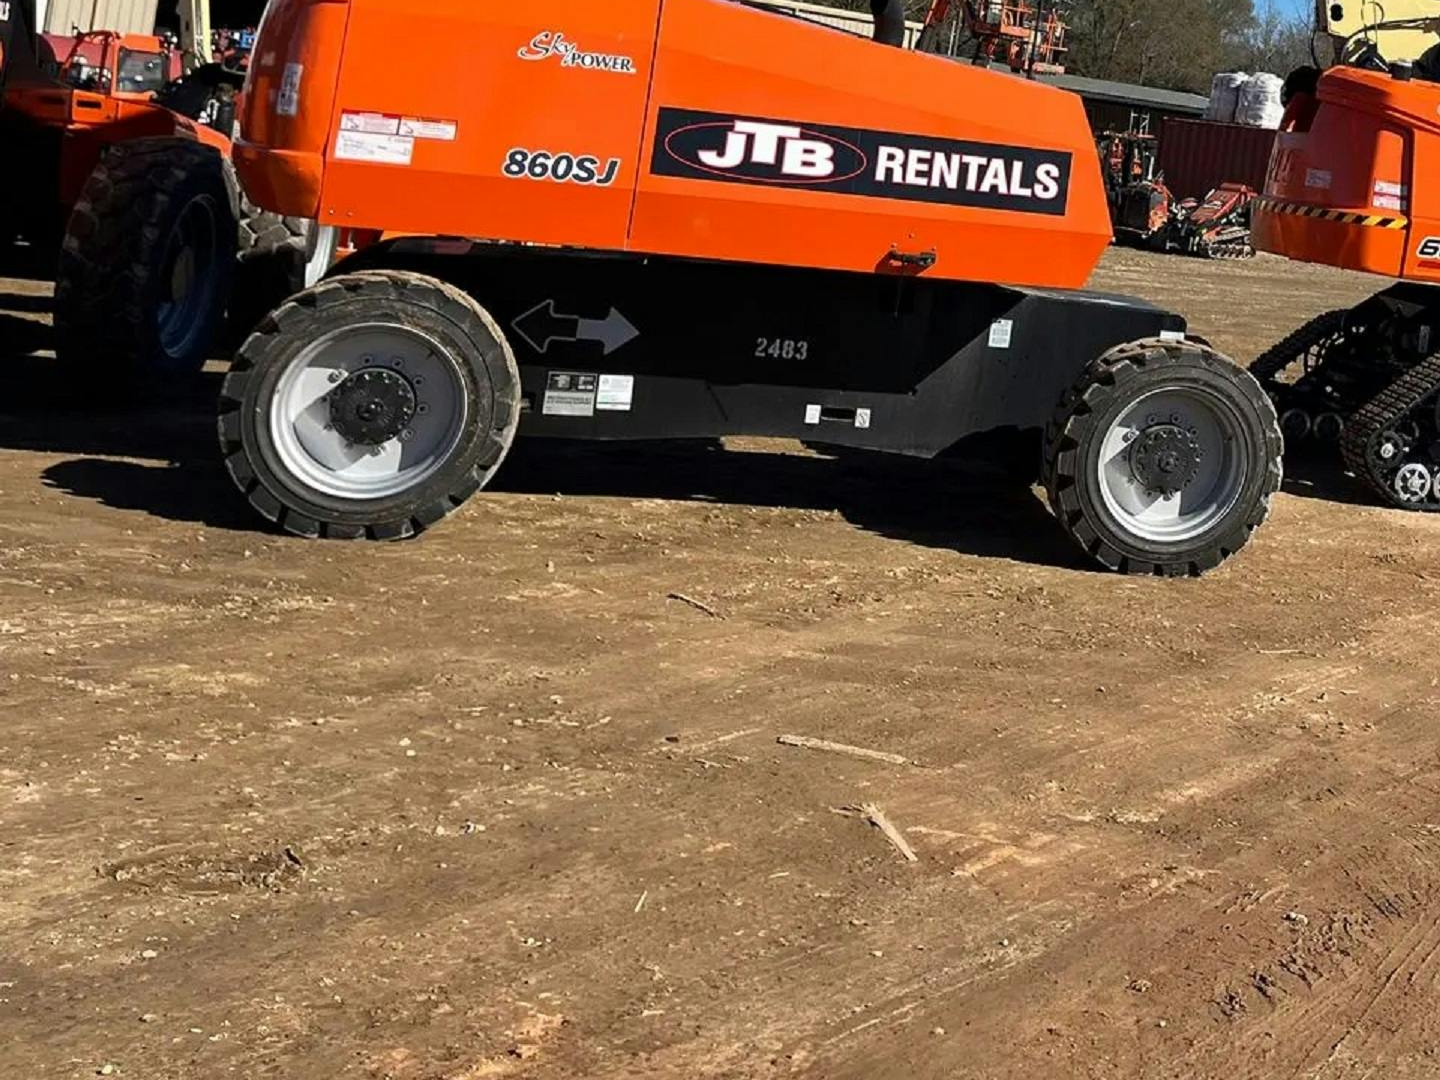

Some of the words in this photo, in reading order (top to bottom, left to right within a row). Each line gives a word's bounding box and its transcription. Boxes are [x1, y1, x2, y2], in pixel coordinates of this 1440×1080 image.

[503, 148, 622, 187] 860SJ
[698, 119, 836, 177] JTB
[875, 145, 1061, 200] RENTALS
[754, 337, 809, 360] 2483
